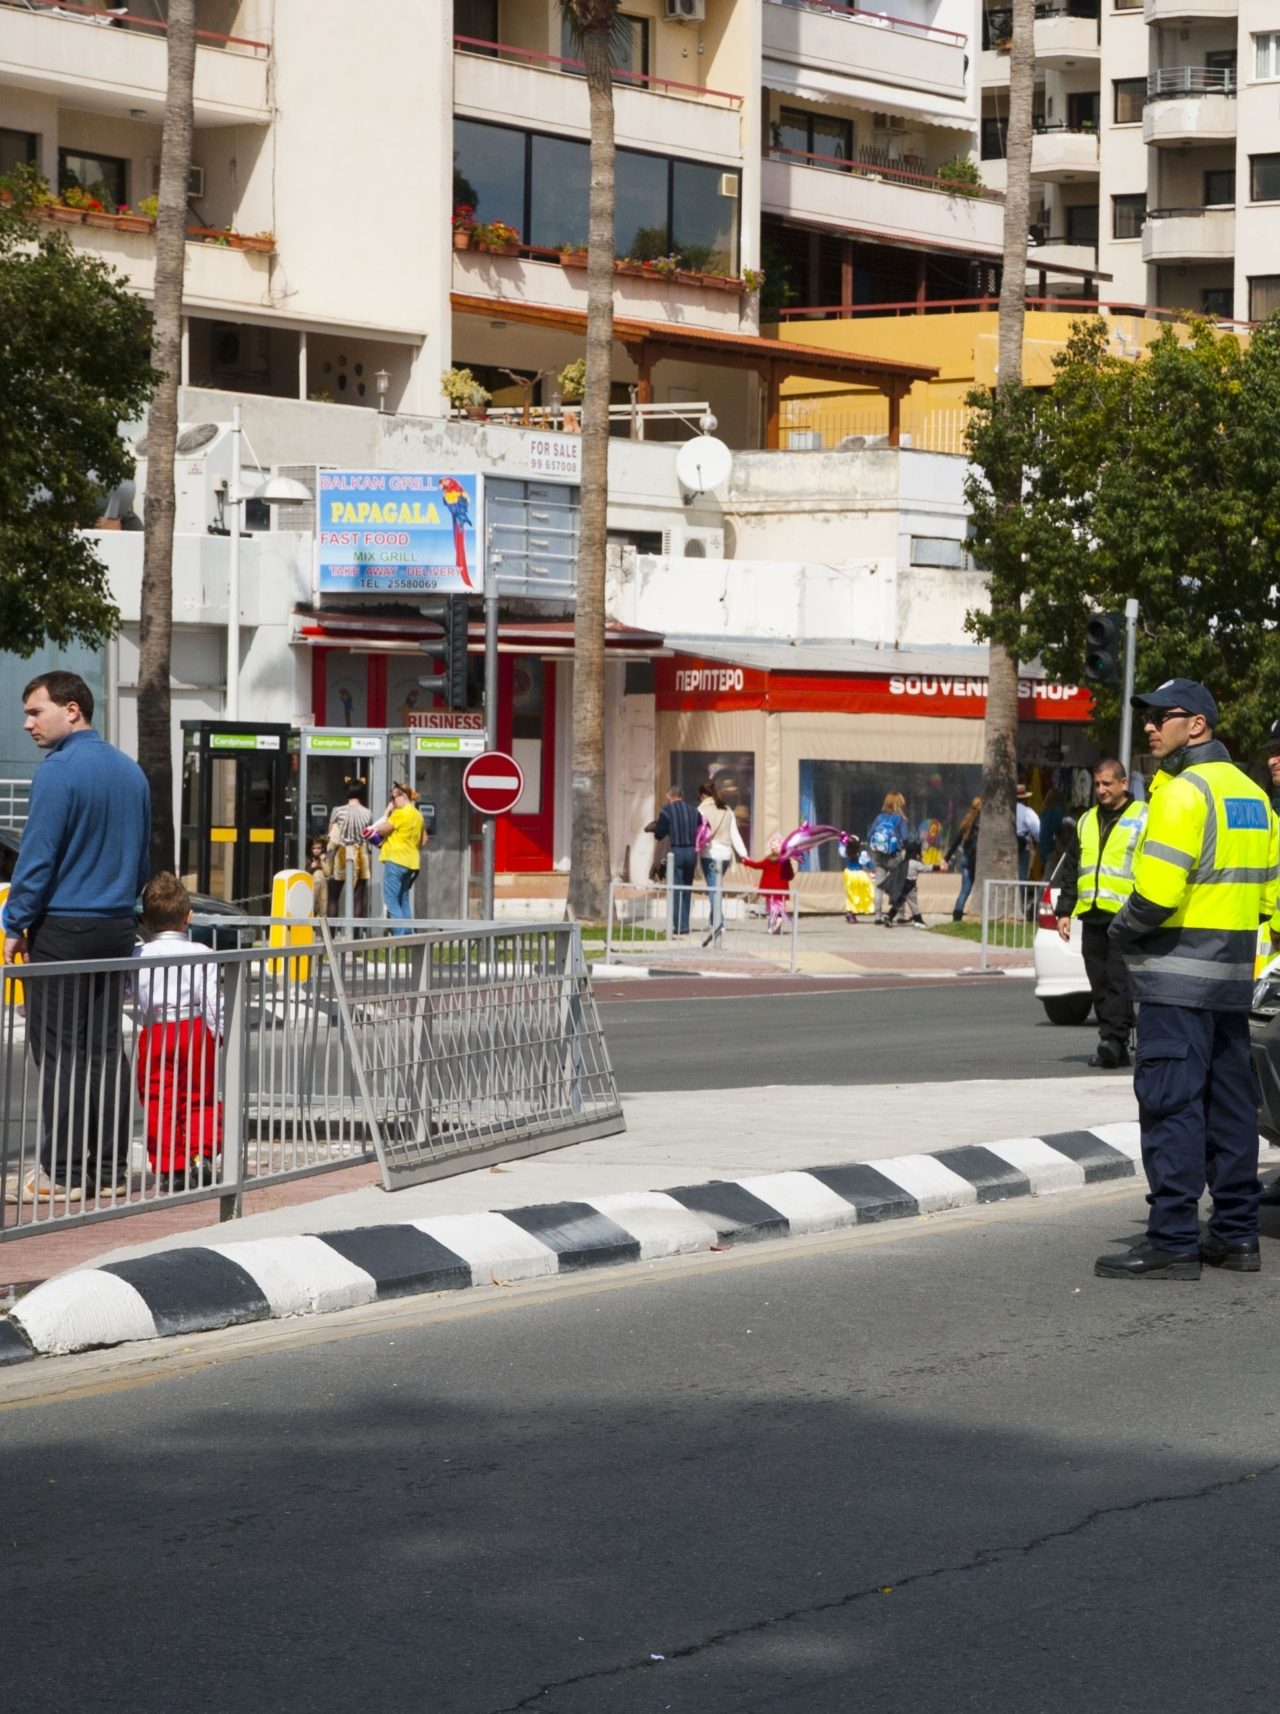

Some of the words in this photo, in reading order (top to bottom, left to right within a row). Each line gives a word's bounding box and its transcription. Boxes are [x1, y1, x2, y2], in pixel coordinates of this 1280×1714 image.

[530, 440, 550, 456] FOR
[553, 442, 577, 459] SALE
[530, 458, 543, 470] 99
[320, 475, 386, 491] BALKAN
[389, 475, 438, 492] GRILL
[330, 501, 440, 525] PAPAGALA
[320, 531, 360, 546] FAST
[365, 532, 409, 546] FOOD
[353, 551, 376, 562] MIX
[380, 551, 418, 562] GRILL
[329, 566, 360, 577] TAKE
[366, 566, 398, 577] AWAY
[407, 566, 463, 577] DELIVERY
[387, 578, 438, 589] 25580069
[889, 675, 989, 697] SOUVENI
[1017, 680, 1078, 700] SHOP
[407, 714, 482, 730] BUSINESS
